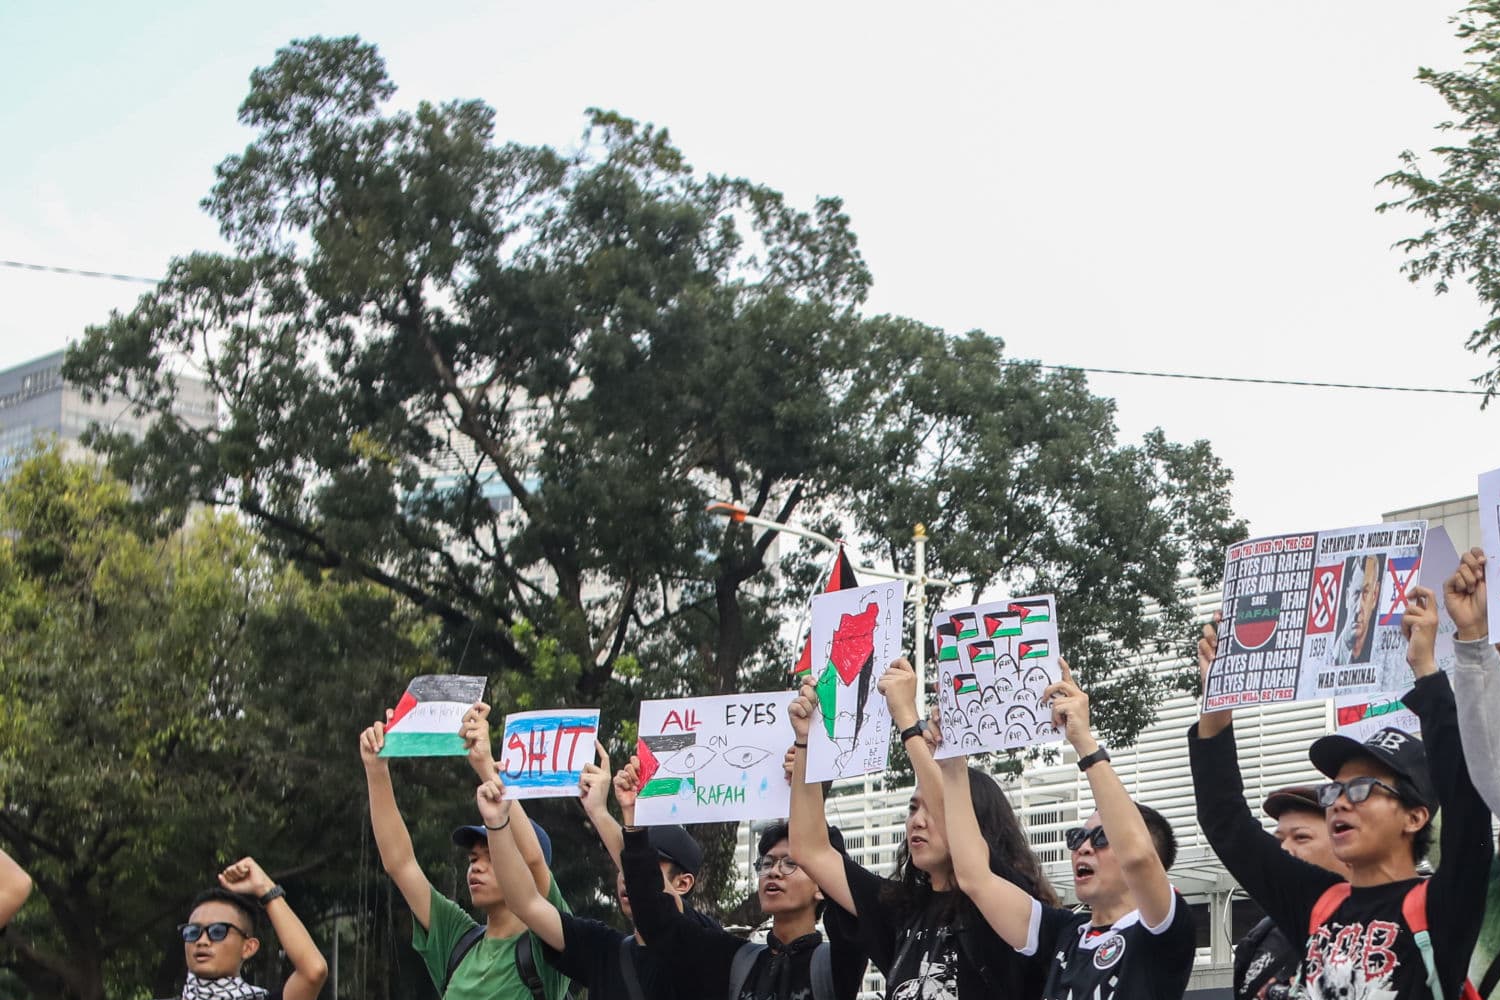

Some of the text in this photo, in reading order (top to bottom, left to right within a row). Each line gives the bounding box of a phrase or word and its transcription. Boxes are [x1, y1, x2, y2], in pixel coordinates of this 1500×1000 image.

[1300, 536, 1314, 549] SEA
[1357, 534, 1365, 550] IS
[1239, 557, 1260, 578] EYES
[1261, 555, 1277, 574] ON
[1277, 551, 1313, 572] RAFAH
[1236, 576, 1257, 597] EYES
[1258, 574, 1275, 593] ON
[1275, 570, 1311, 591] RAFAH
[1250, 595, 1268, 606] SAVE
[1308, 637, 1327, 658] 1939
[876, 588, 895, 733] PALESINE
[1225, 654, 1247, 675] EYES
[1248, 651, 1264, 671] ON
[1264, 648, 1300, 669] RAFAH
[1223, 672, 1245, 694] EYES
[1246, 671, 1262, 690] ON
[1262, 668, 1298, 689] RAFAH
[1318, 667, 1377, 689] WAR CRIMINAL
[1241, 691, 1259, 703] WILL
[1262, 689, 1271, 701] BE
[1274, 688, 1294, 699] FREE
[660, 702, 776, 734] ALL EYES
[981, 721, 997, 730] RIP
[709, 735, 728, 748] ON
[1009, 732, 1022, 740] RIP
[504, 721, 597, 779] SHIT
[864, 756, 882, 769] FREE
[697, 784, 745, 806] RAFAH
